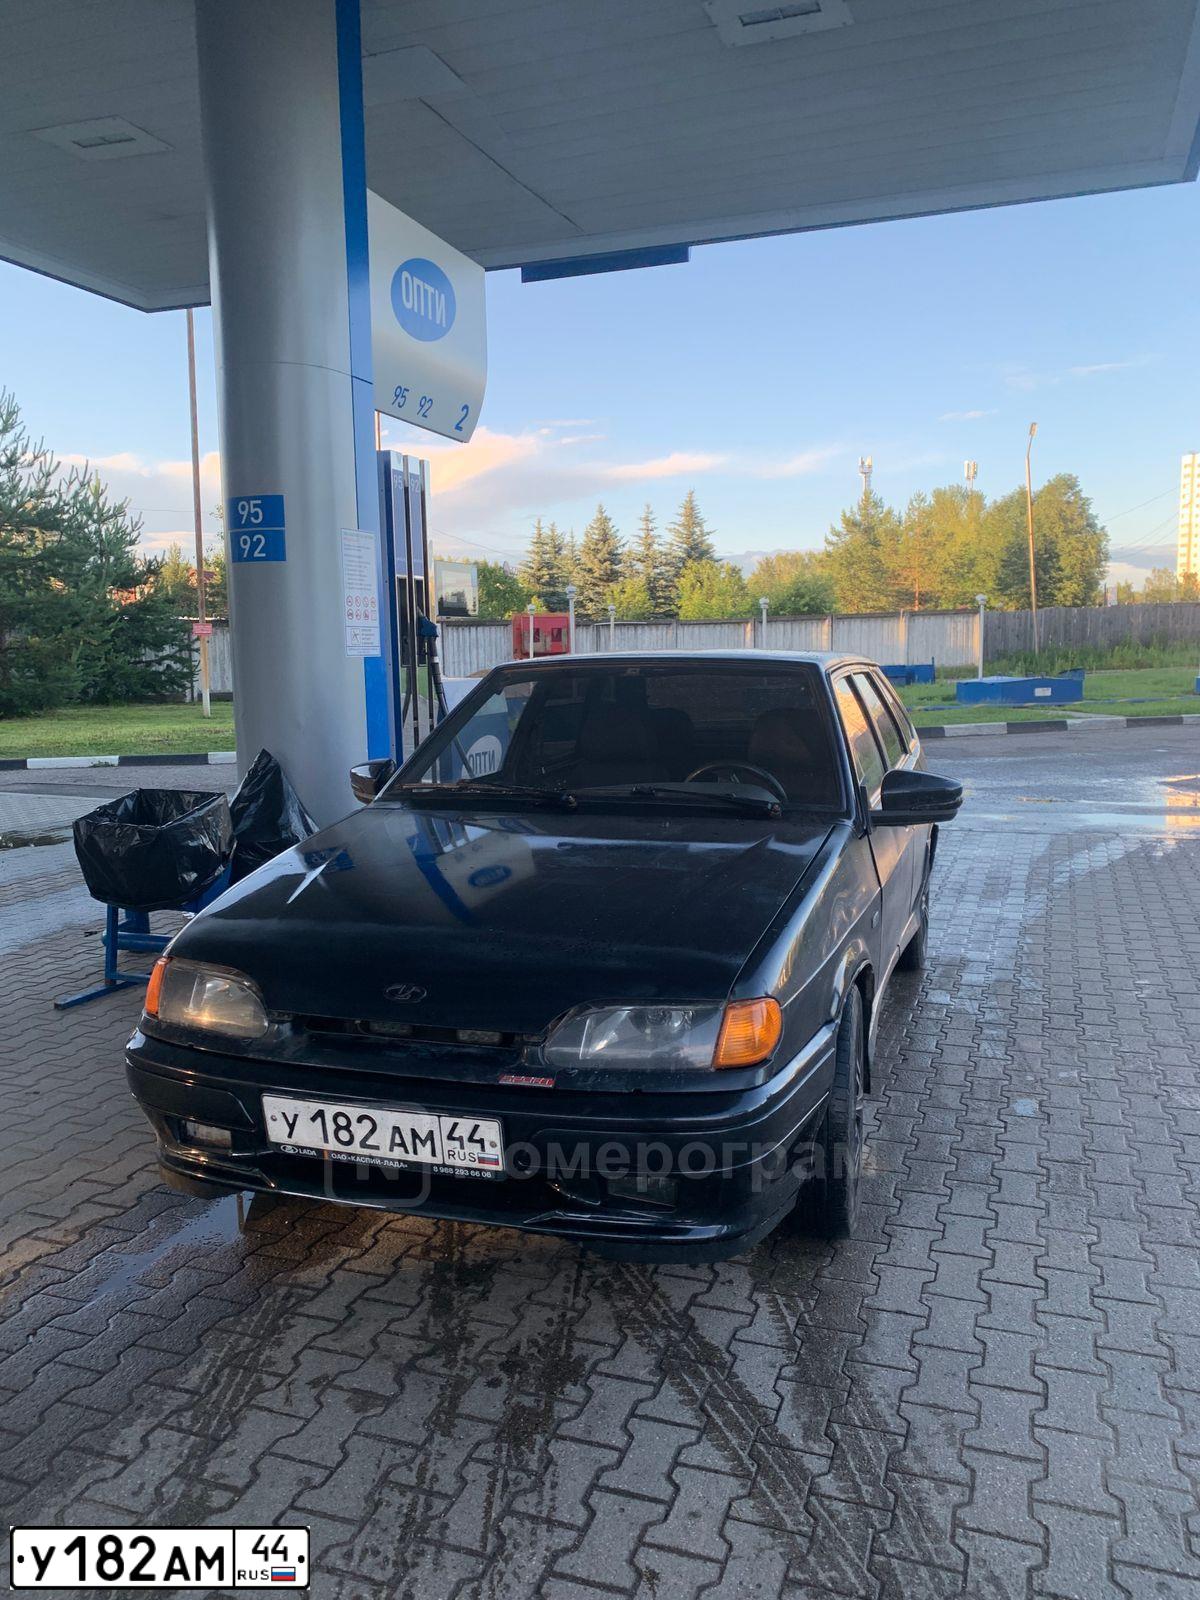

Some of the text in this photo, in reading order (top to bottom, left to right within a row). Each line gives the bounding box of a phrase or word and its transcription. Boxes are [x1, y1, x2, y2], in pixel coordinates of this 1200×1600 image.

[401, 270, 447, 328] ОПТИ
[391, 385, 470, 432] 95 92 2
[237, 500, 264, 525] 95
[239, 534, 267, 559] 92
[446, 1121, 486, 1153] 44
[299, 1148, 317, 1157] LADA
[331, 1152, 347, 1160] ОАО
[447, 1149, 477, 1163] RUS
[433, 1165, 439, 1173] 8
